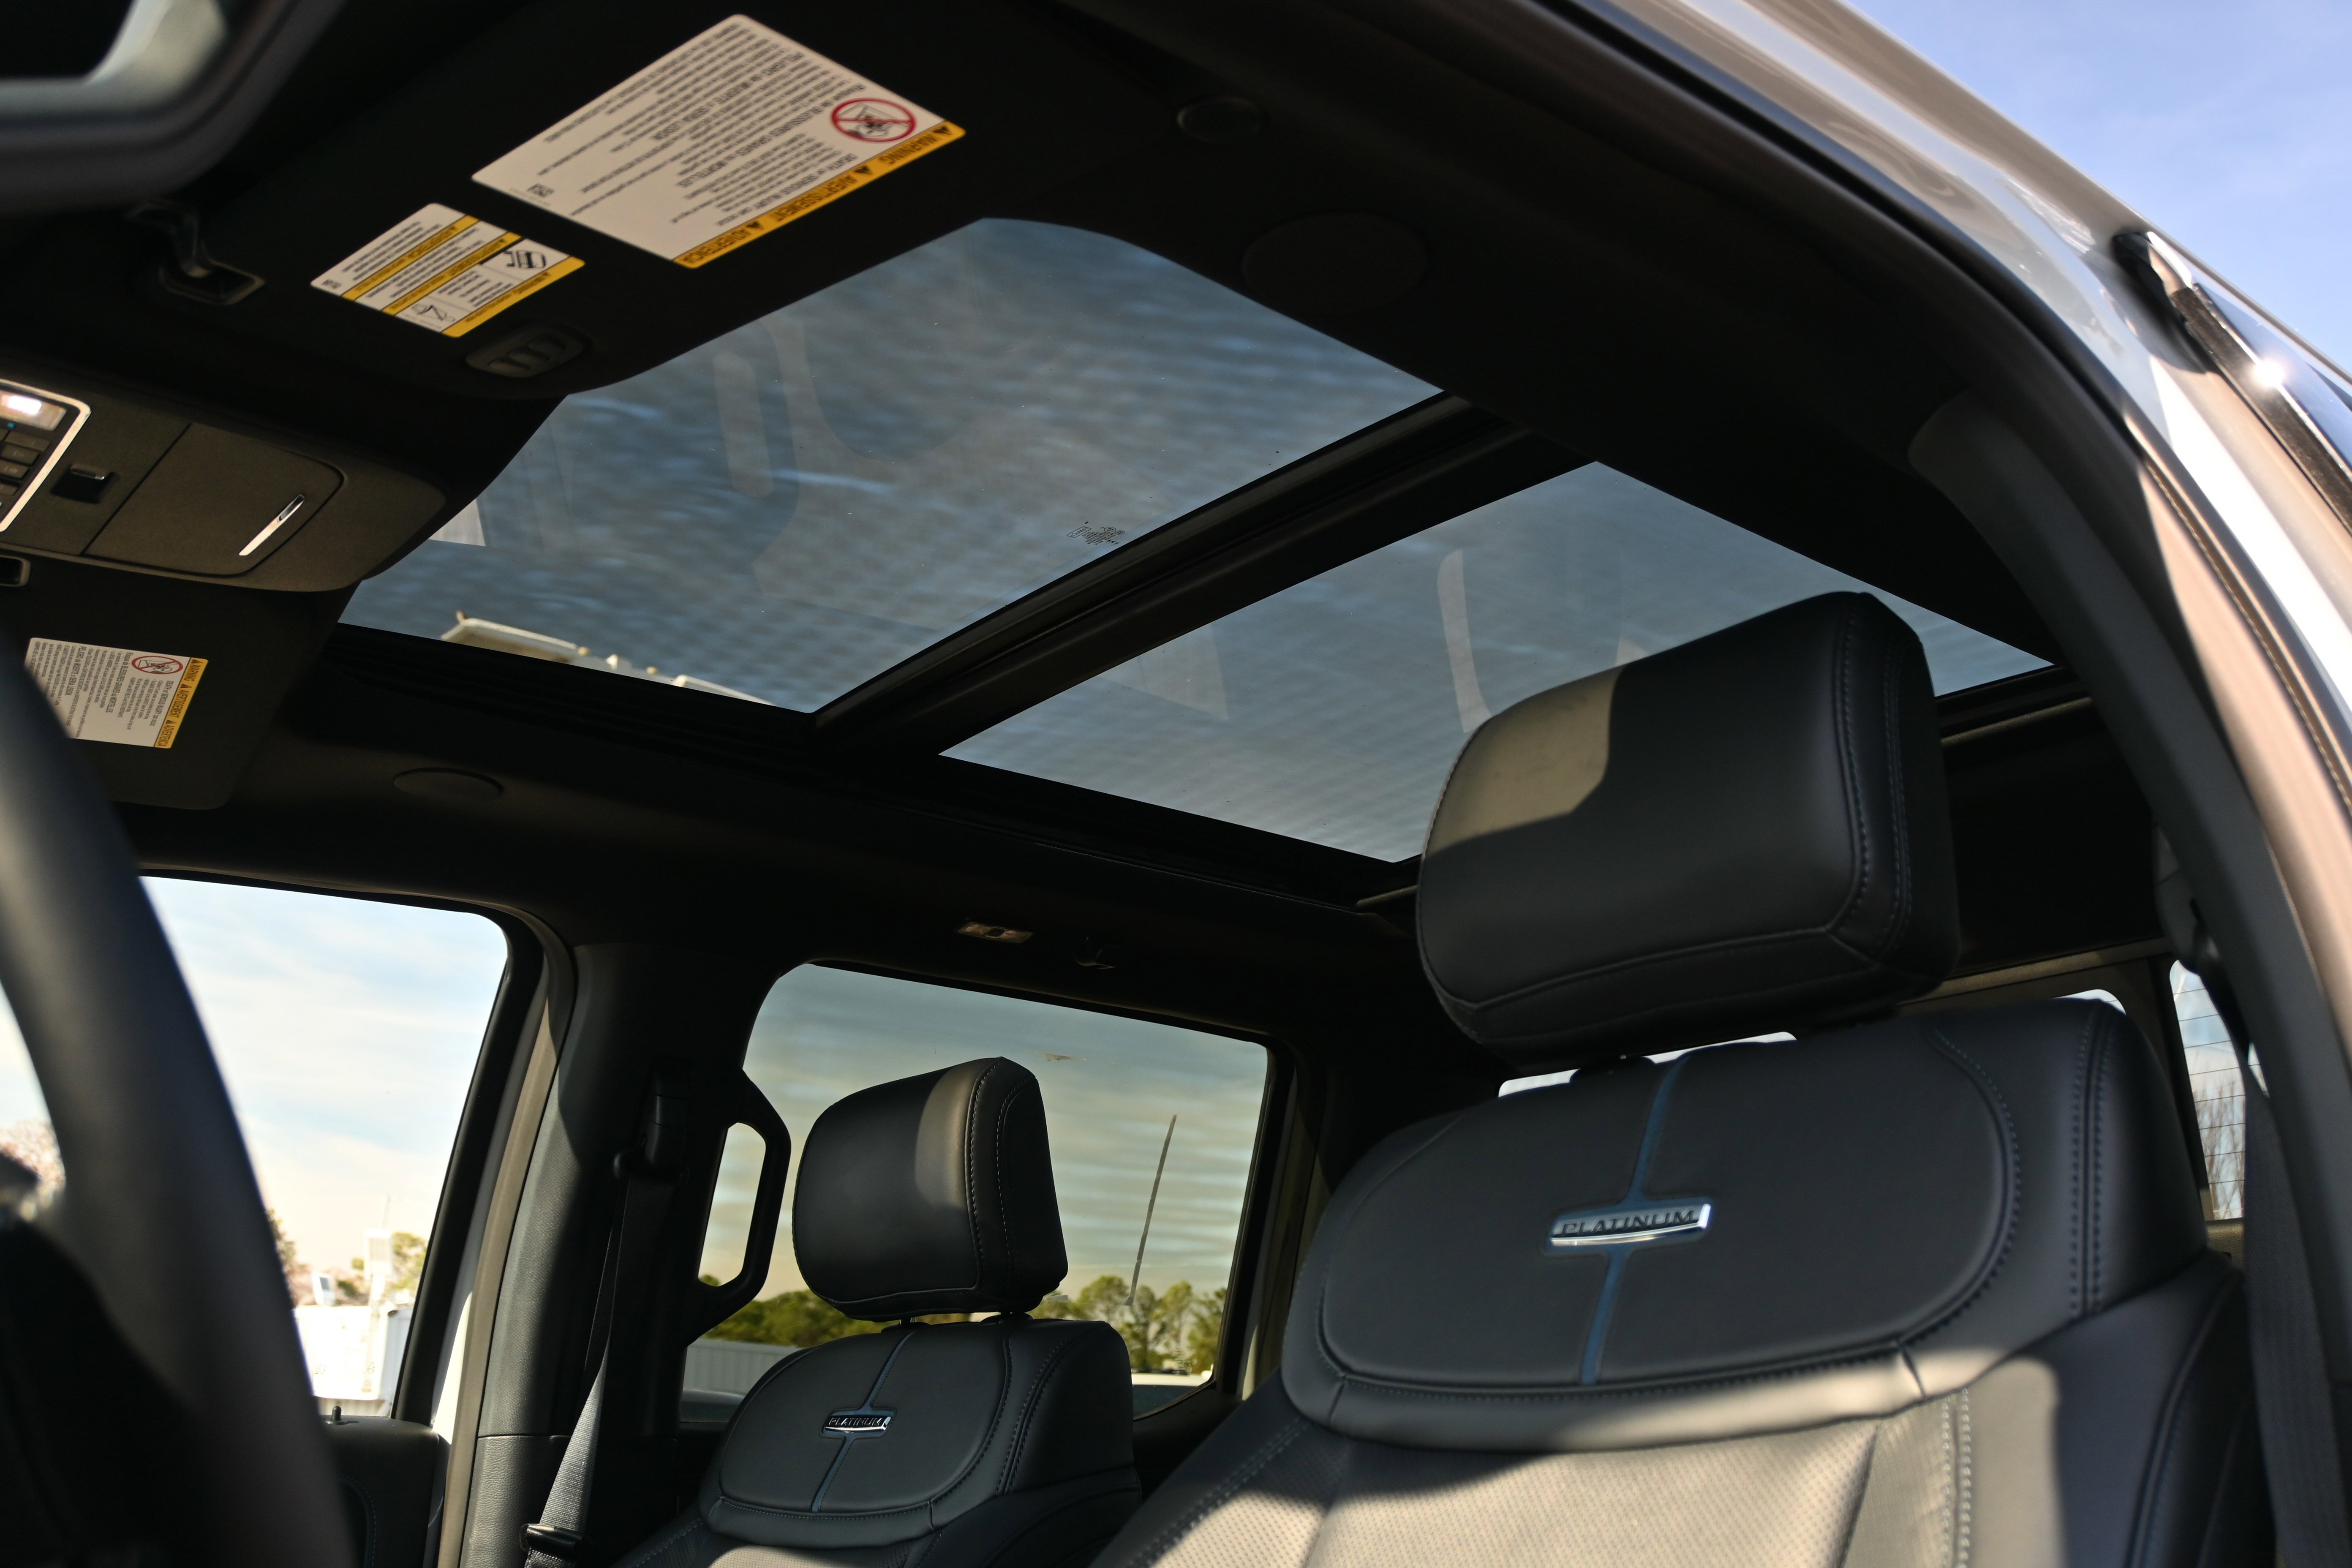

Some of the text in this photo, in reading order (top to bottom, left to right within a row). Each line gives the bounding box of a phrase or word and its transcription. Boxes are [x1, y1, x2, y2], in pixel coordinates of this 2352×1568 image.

[877, 132, 942, 165] WARNING
[765, 173, 860, 221] AVERTISSEMENT
[679, 227, 754, 264] ADVERTENCIA
[184, 664, 201, 681] WARNING
[168, 689, 190, 718] AVERTISSEMENT
[156, 724, 176, 747] ADVERTENCIA
[1561, 1208, 1695, 1235] PLATINUM
[828, 1417, 883, 1426] PLATINUM
